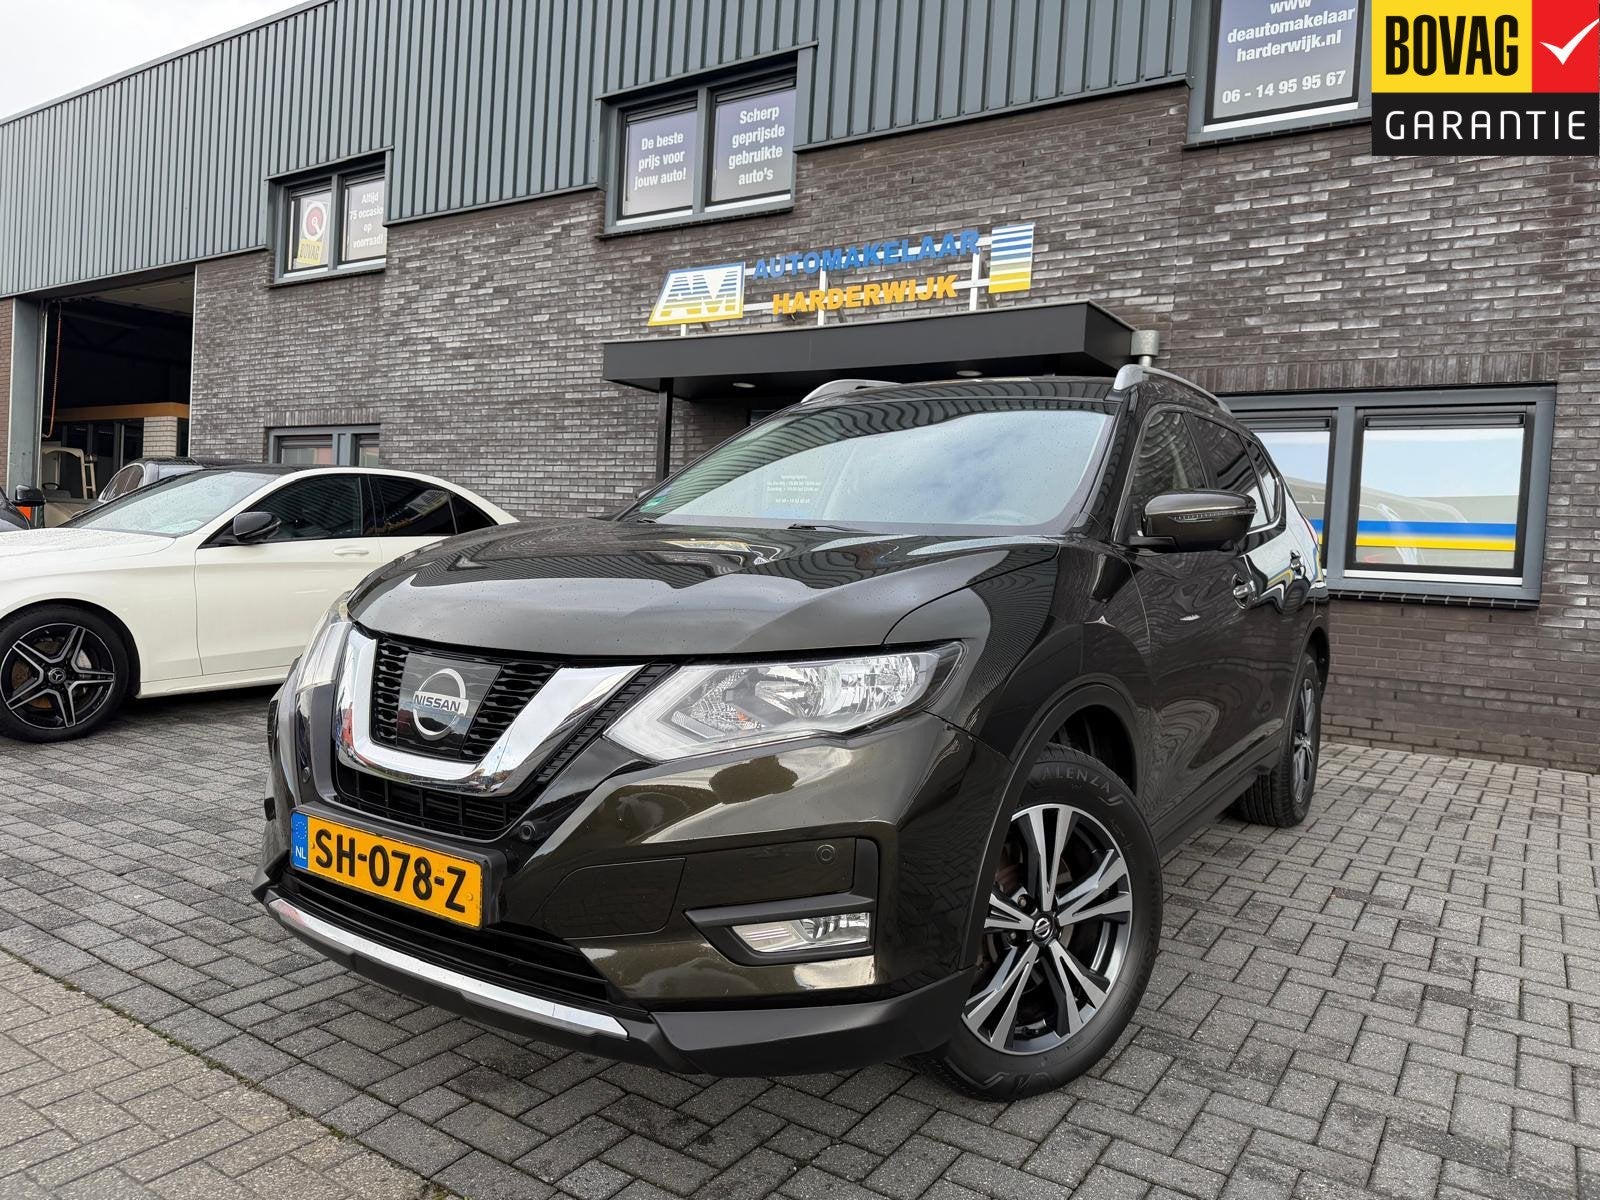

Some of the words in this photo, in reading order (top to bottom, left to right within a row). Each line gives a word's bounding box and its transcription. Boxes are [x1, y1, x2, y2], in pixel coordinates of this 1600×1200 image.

[1270, 0, 1313, 14] www
[1227, 8, 1356, 43] deautomakelaar
[1236, 29, 1342, 62] harderwijk.nl
[1222, 89, 1241, 104] 06
[1256, 83, 1275, 98] 14
[1278, 78, 1298, 95] 95
[1302, 74, 1322, 91] 95
[1325, 70, 1346, 87] 67
[739, 106, 780, 124] Scherp
[641, 137, 654, 150] De
[656, 131, 684, 148] beste
[732, 124, 785, 148] geprijsde
[638, 154, 660, 172] prijs
[662, 150, 685, 165] voor
[728, 145, 783, 170] gebruikte
[634, 174, 659, 191] jouw
[660, 167, 687, 184] auto!
[738, 167, 774, 185] auto's
[363, 223, 372, 234] op
[752, 229, 981, 280] AUTOMAKELAAR
[772, 274, 959, 315] HARDERWIJK
[413, 694, 461, 712] NISSAN
[1041, 766, 1111, 794] ALENZA
[295, 845, 307, 860] NL
[315, 828, 467, 914] SH-078-Z
